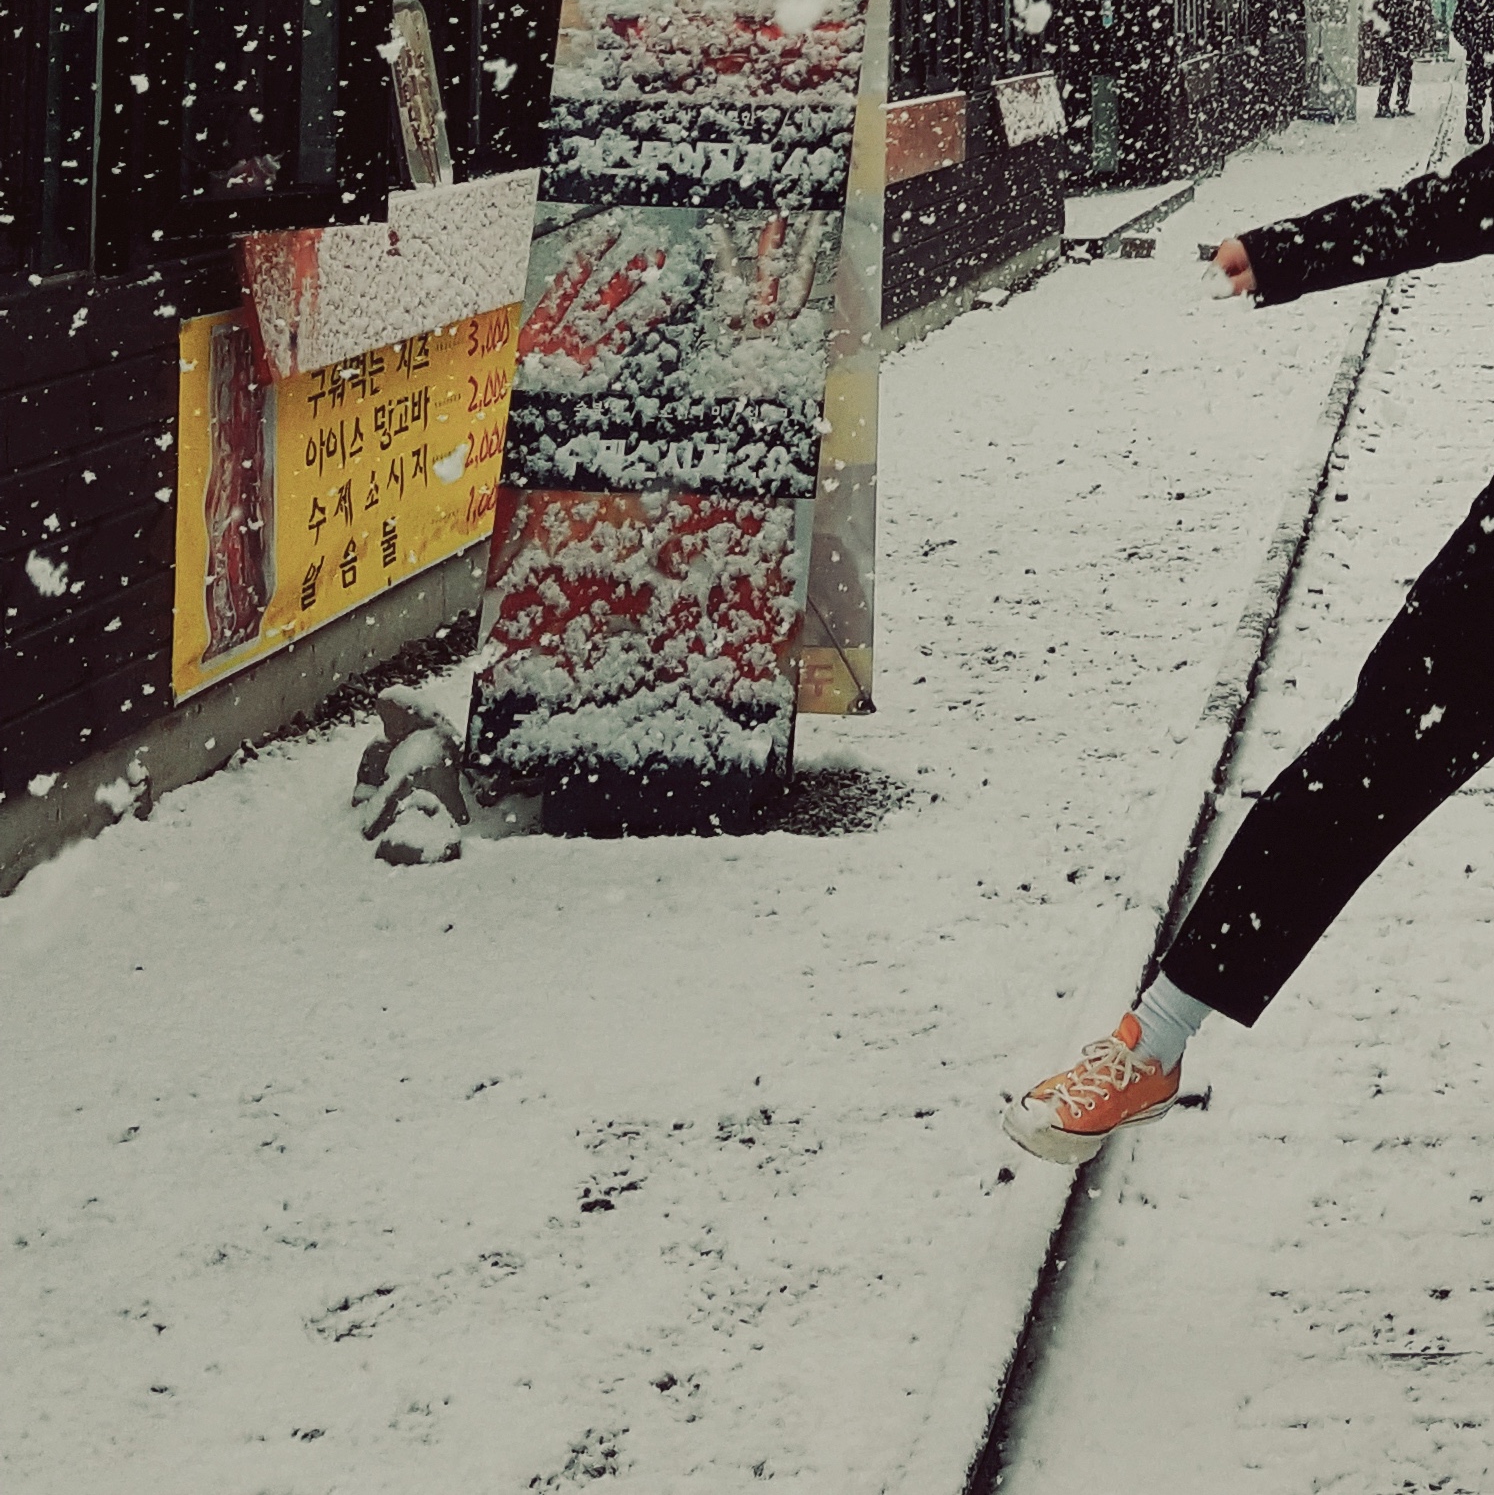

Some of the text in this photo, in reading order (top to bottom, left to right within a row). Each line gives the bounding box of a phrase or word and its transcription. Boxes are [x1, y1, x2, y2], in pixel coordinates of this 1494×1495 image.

[395, 332, 429, 380] 치즈
[467, 308, 510, 358] 3,000
[306, 416, 364, 477] 아이스
[374, 386, 430, 451] 망고바
[467, 367, 508, 413] 2,000
[466, 476, 498, 524] 1,00
